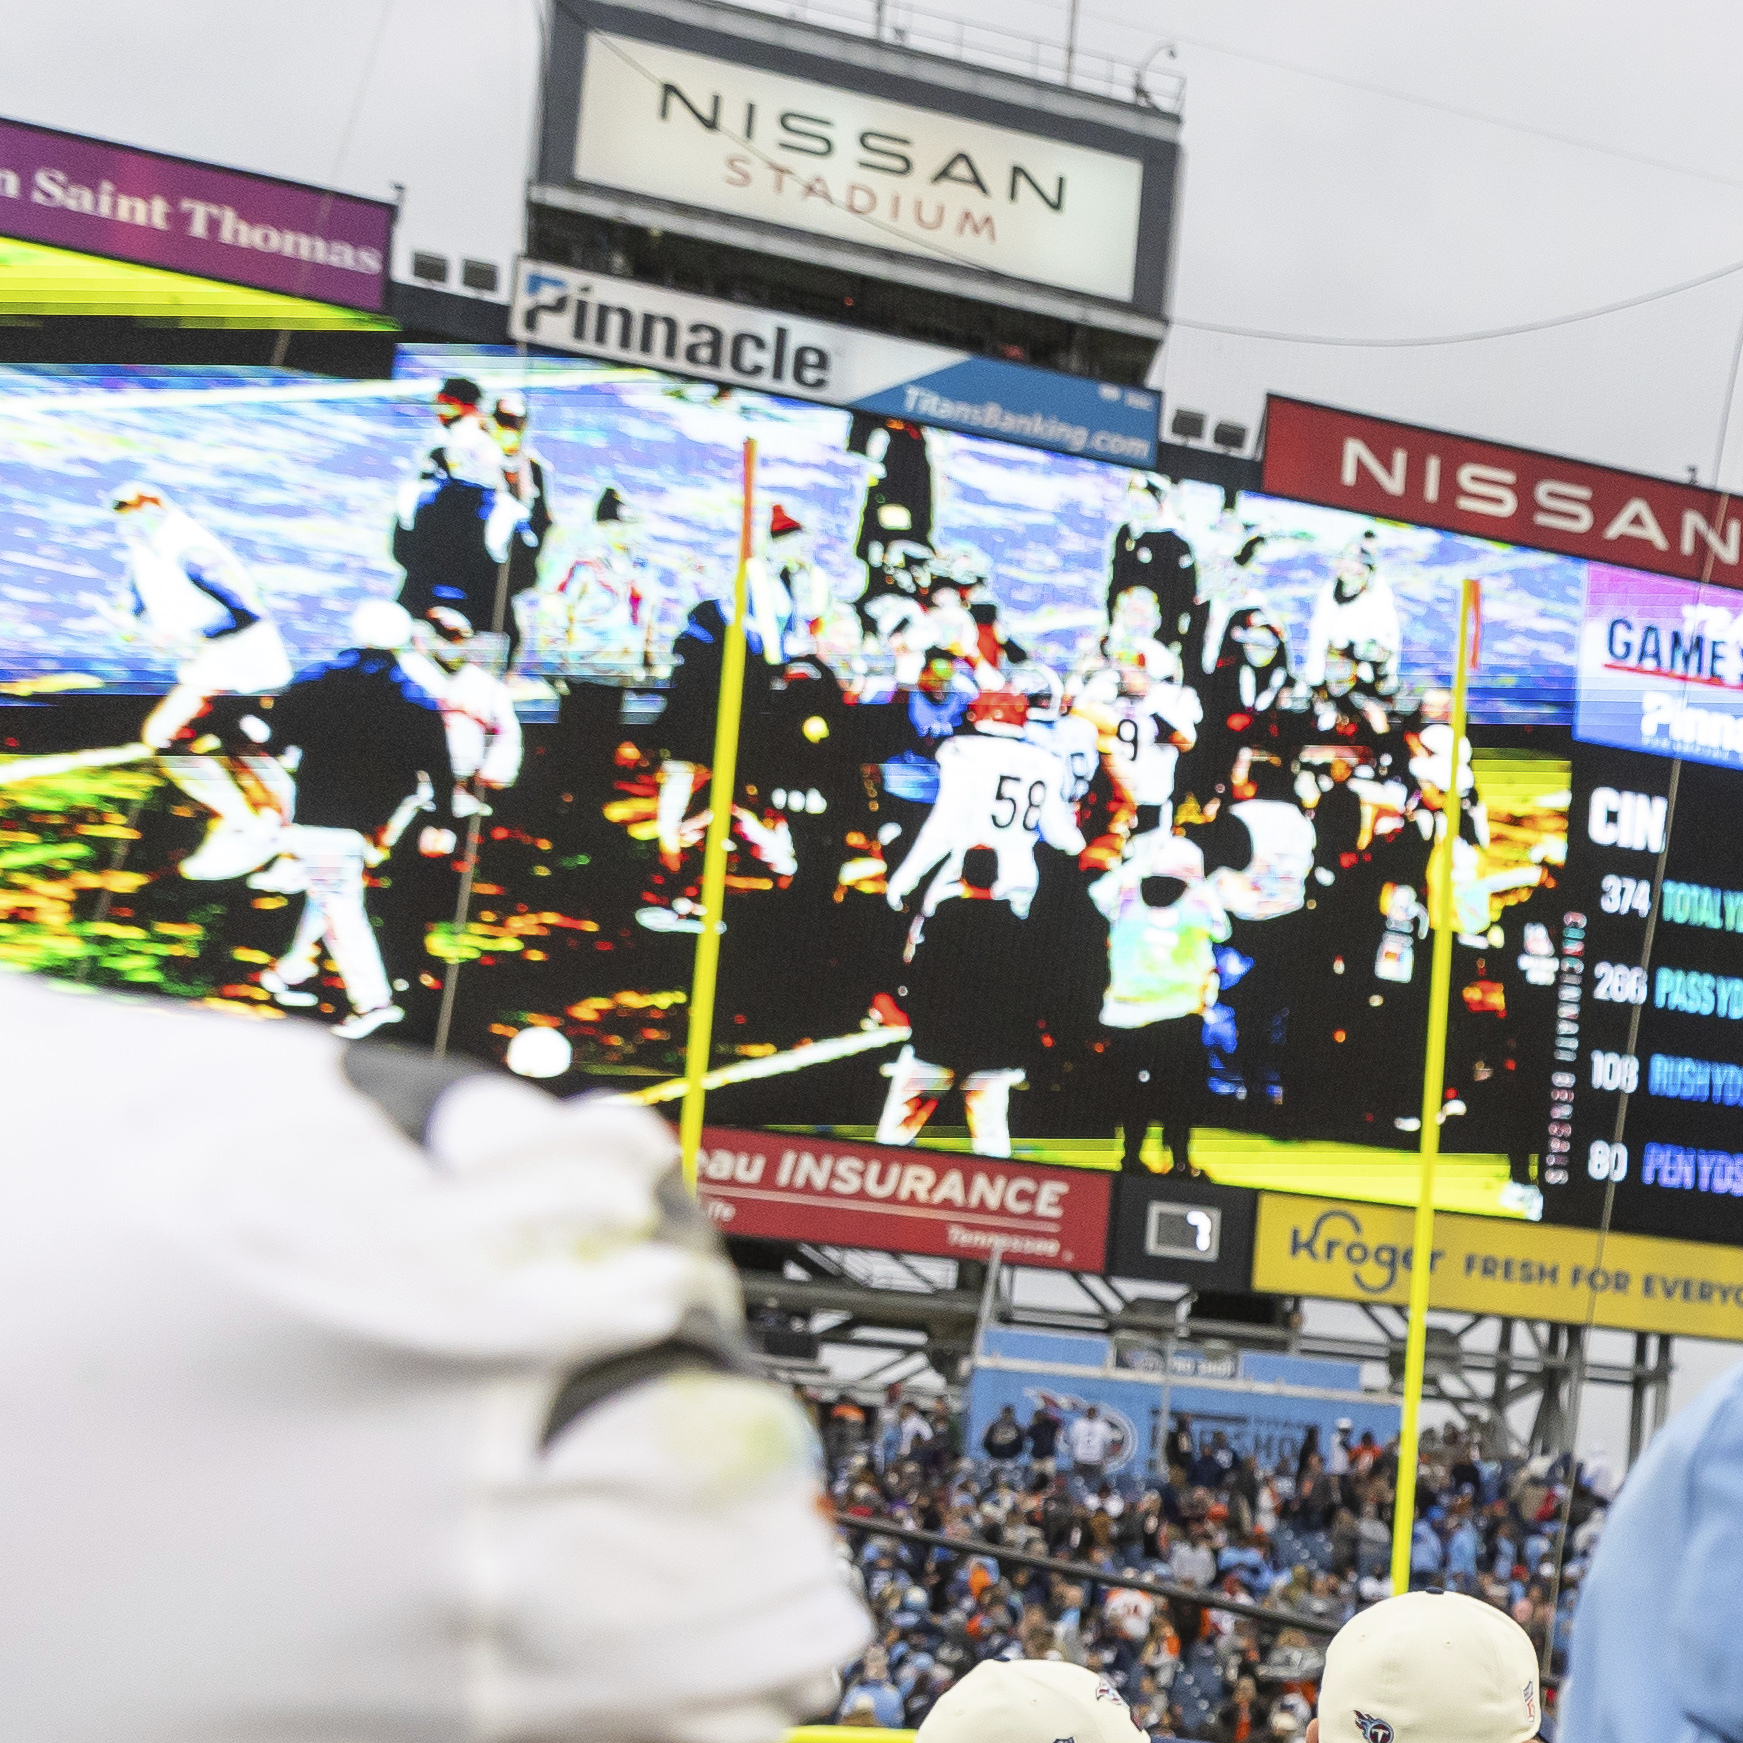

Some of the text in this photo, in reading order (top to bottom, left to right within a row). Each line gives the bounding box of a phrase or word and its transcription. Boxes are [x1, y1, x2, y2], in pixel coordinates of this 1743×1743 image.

[658, 82, 1068, 213] NISSAN
[31, 168, 169, 231] Saint
[180, 197, 383, 277] Thomas
[724, 155, 998, 244] STADIUM
[525, 273, 831, 390] Pinnacle
[1340, 437, 1742, 566] NISSAN
[1607, 618, 1727, 679] GAME
[1588, 786, 1668, 853] CIN
[1601, 874, 1651, 918] 374
[1662, 880, 1723, 932] TOTAL
[1655, 966, 1714, 1017] PASS
[1591, 1050, 1639, 1094] 108
[776, 1149, 1071, 1218] INSURANCE
[1588, 1139, 1628, 1182] 80
[1464, 1253, 1560, 1286] FRESH
[1570, 1263, 1631, 1296] FOR
